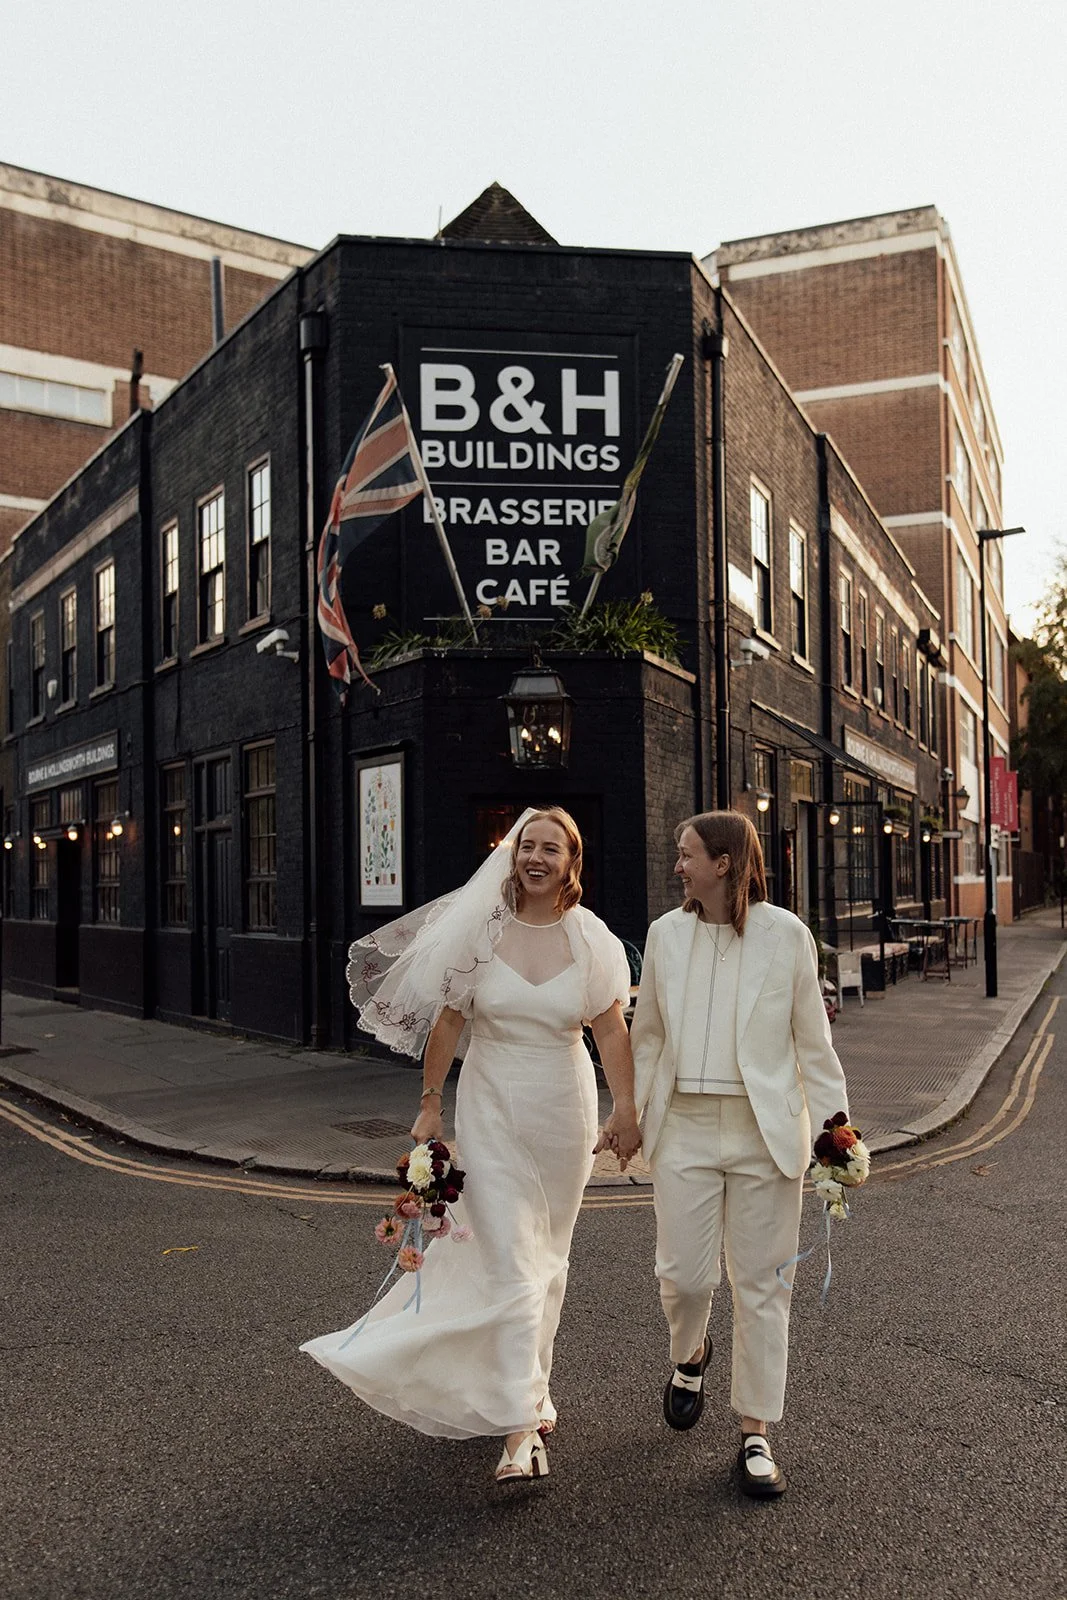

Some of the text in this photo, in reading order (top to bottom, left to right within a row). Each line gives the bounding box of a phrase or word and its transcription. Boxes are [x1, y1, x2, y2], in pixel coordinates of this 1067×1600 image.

[420, 363, 620, 437] B&H
[421, 439, 620, 472] BUILDINGS
[485, 539, 562, 566] BAR
[475, 573, 570, 606] CAFÉ
[86, 743, 114, 765] BUILDINGS
